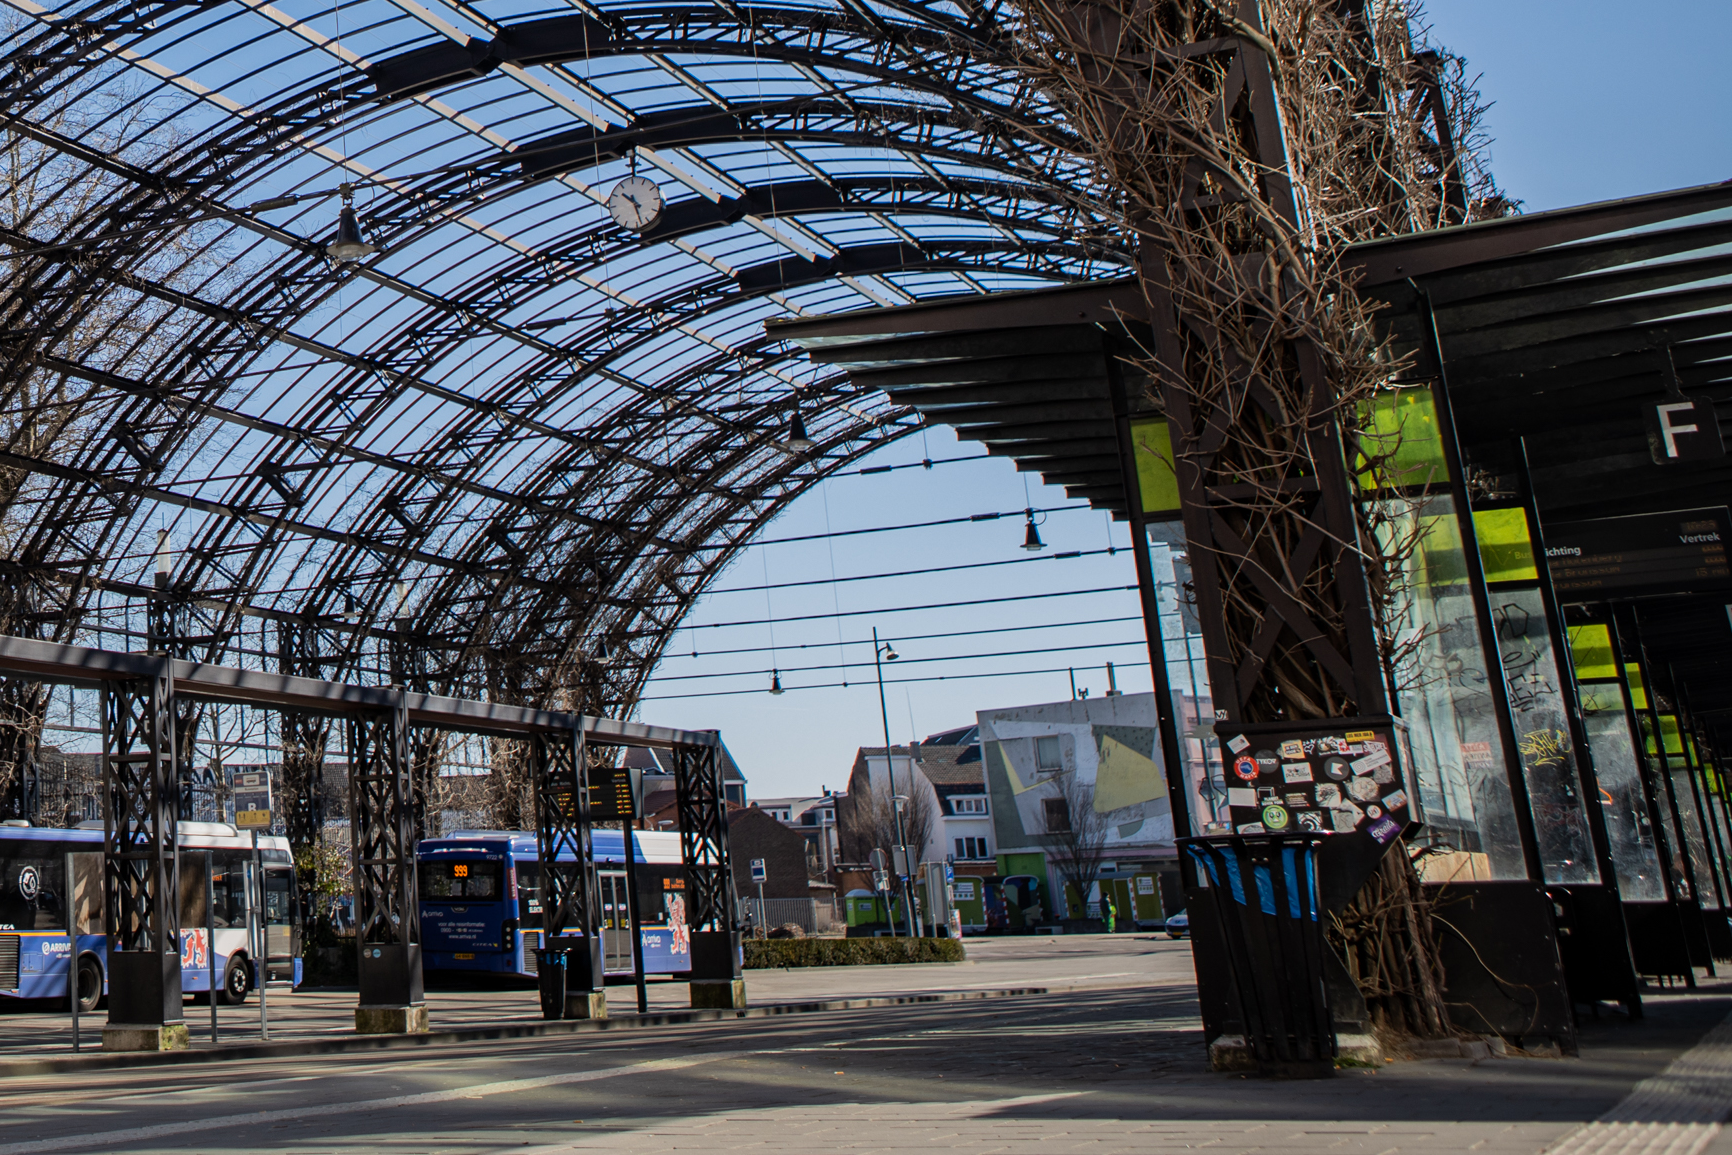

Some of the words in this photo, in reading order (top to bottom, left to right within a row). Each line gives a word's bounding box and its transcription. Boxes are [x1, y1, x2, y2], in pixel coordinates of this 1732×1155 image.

[1656, 402, 1699, 458] F
[1545, 545, 1582, 558] ichting
[1680, 533, 1720, 544] Vertrek
[1554, 579, 1602, 590] runssum
[248, 802, 256, 812] B
[454, 864, 468, 877] 999
[647, 934, 661, 943] arriva
